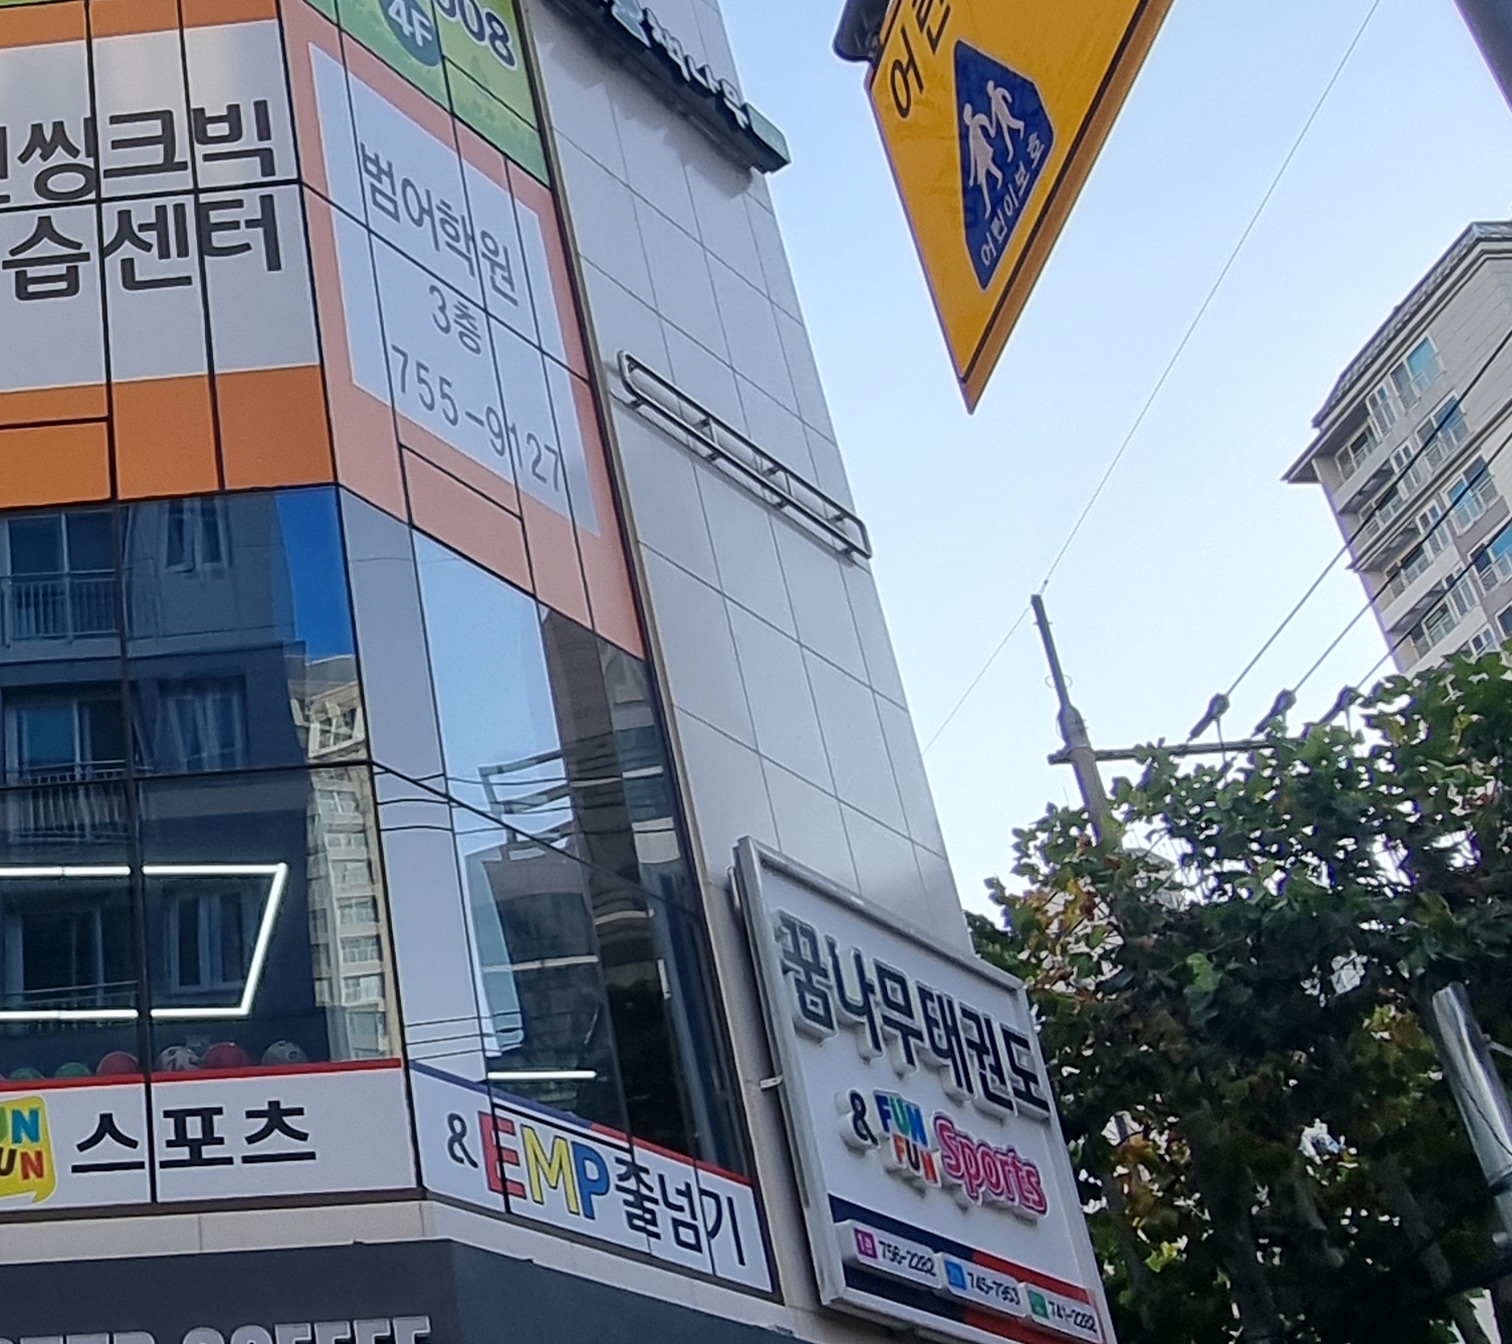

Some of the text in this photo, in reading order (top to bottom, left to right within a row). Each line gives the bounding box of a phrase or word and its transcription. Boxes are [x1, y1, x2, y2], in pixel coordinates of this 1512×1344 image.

[361, 142, 519, 307] 범어학원
[980, 132, 1045, 266] 어린이보호
[427, 284, 482, 355] 3층
[390, 345, 562, 492] 755-9127
[780, 911, 1050, 1119] 꿈나무태권도
[70, 1100, 318, 1176] 스포츠
[850, 1091, 878, 1145] &
[875, 1091, 1048, 1218] FUN Sports
[894, 1134, 940, 1185] FUN
